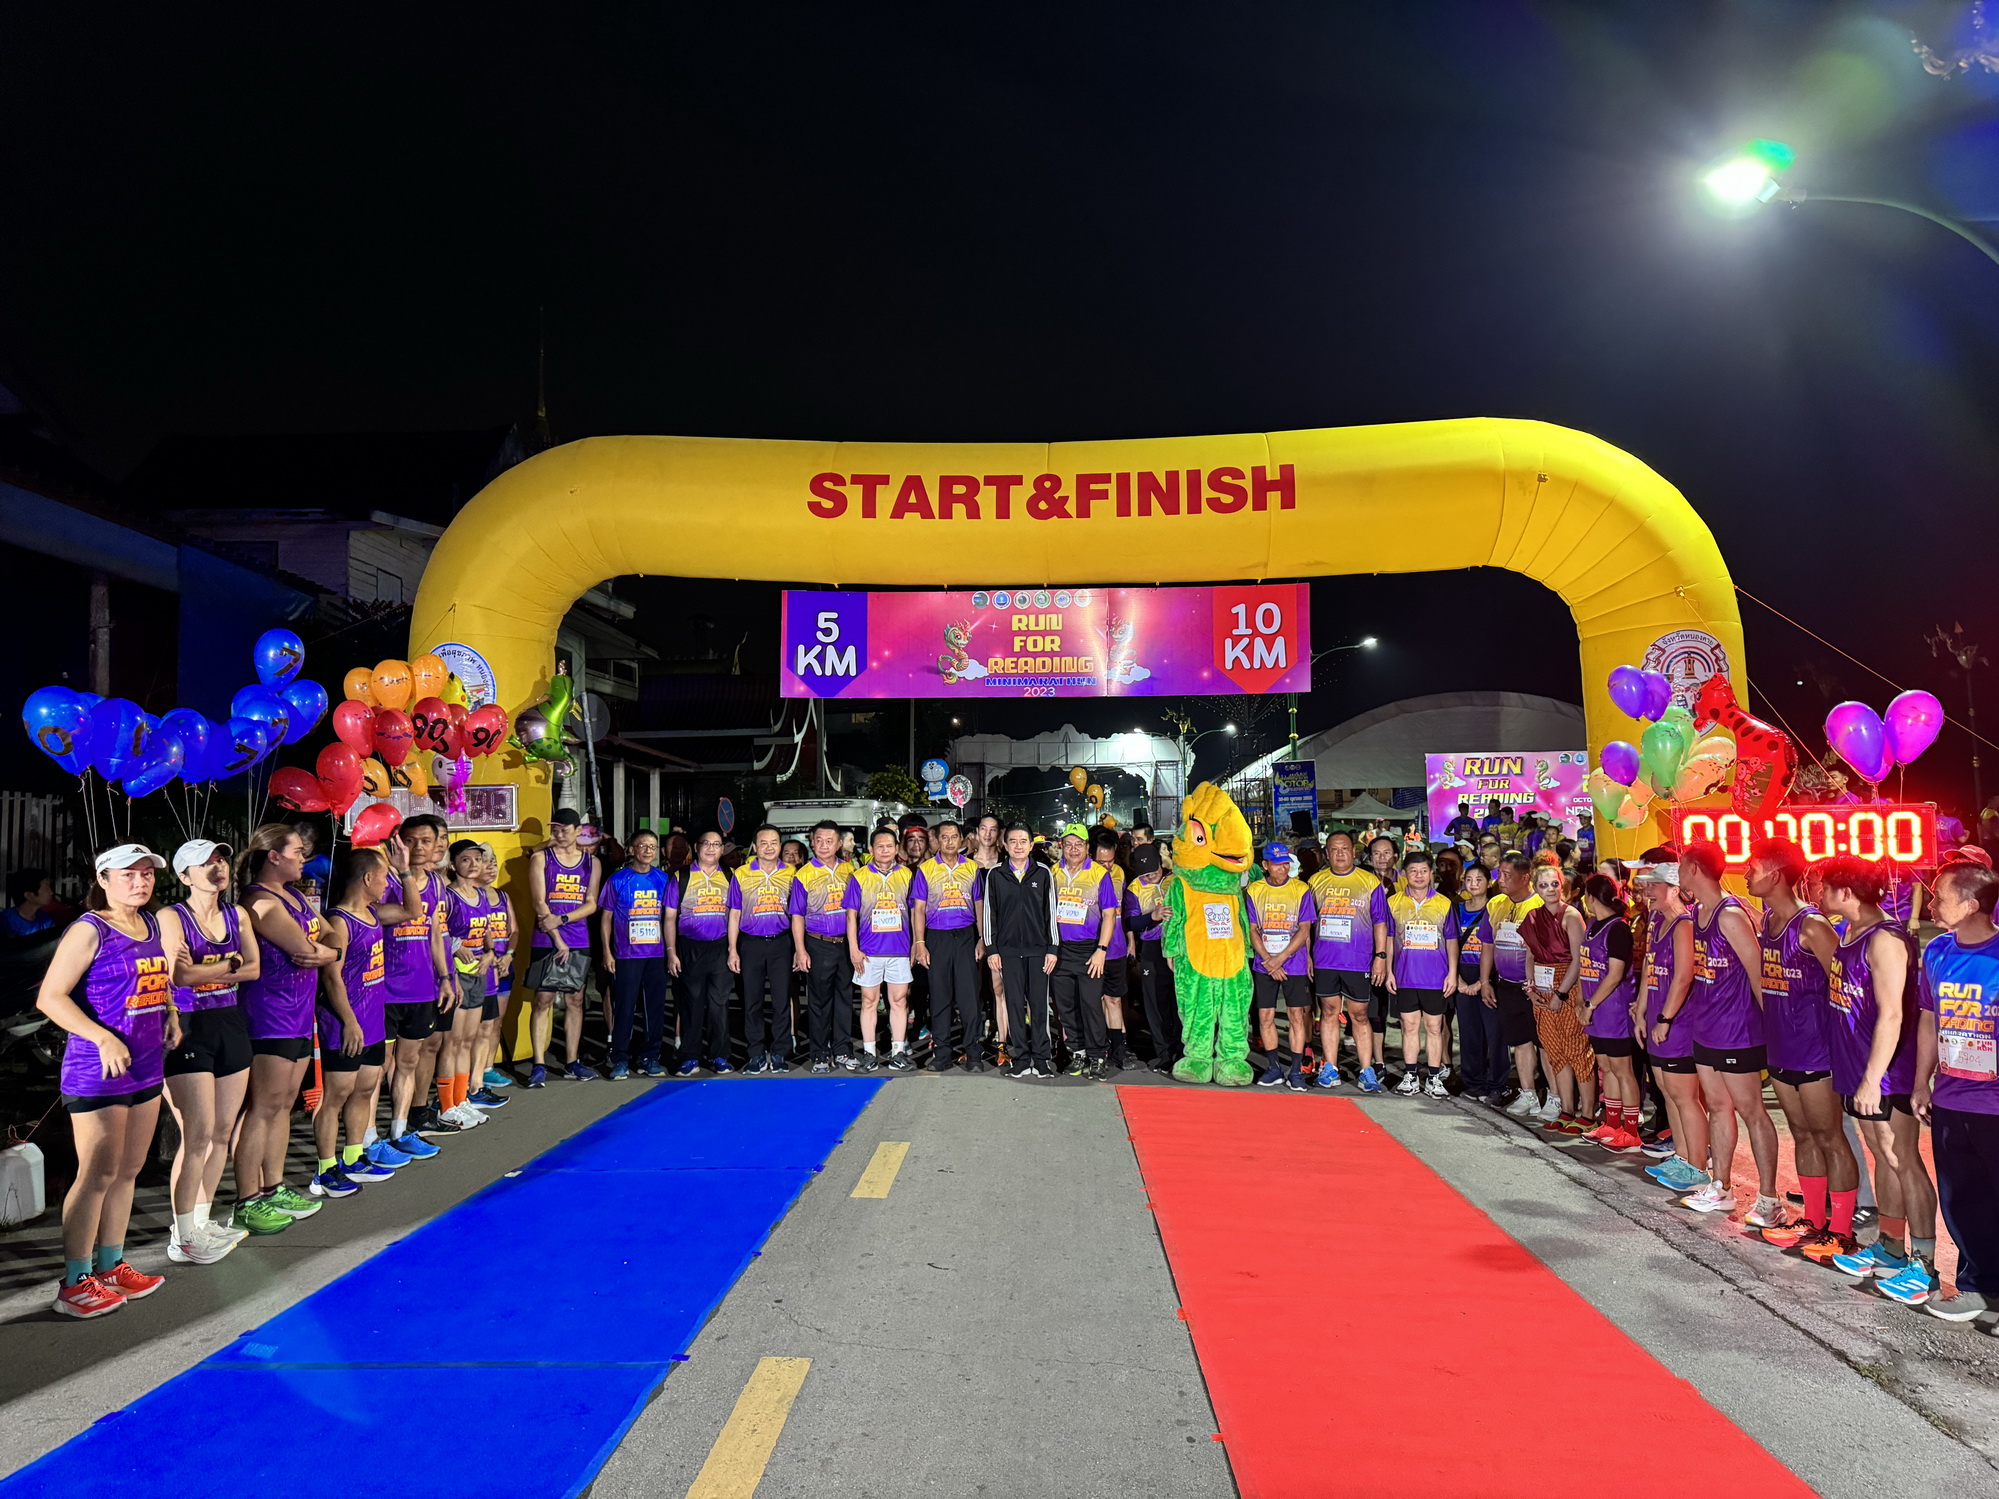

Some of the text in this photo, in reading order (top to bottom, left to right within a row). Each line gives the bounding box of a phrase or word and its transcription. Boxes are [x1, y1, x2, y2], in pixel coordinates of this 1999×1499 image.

[807, 464, 1296, 520] START&FINISH
[1012, 614, 1063, 631] RUN
[1231, 602, 1282, 635] 10
[816, 612, 839, 643] 5
[1013, 636, 1061, 652] FOR
[1224, 636, 1287, 670] KM
[797, 644, 857, 676] KM
[987, 657, 1094, 674] READING
[985, 677, 1097, 687] MINIMARATHON
[1023, 686, 1056, 697] 2023
[1464, 757, 1523, 776] RUN
[556, 874, 580, 883] RUN
[555, 883, 580, 892] FOR
[698, 887, 721, 896] RUN
[758, 886, 779, 895] RUN
[827, 883, 846, 892] RUN
[943, 882, 962, 891] RUN
[634, 890, 657, 898] RUN
[877, 892, 895, 900] RUN
[1060, 888, 1082, 896] RUN
[1326, 888, 1350, 896] RUN
[634, 898, 657, 908] FOR
[698, 896, 722, 905] FOR
[758, 895, 780, 905] FOR
[1325, 897, 1350, 906] FOR
[1265, 903, 1286, 911] RUN
[1265, 912, 1286, 921] FOR
[470, 917, 487, 927] RUN
[1763, 948, 1780, 962] RUN
[136, 956, 168, 974] RUN
[1708, 957, 1728, 967] 2023
[1763, 963, 1783, 978] FOR
[137, 974, 168, 992] FOR
[1938, 982, 1982, 999] RUN
[1940, 999, 1981, 1017] FOR
[1940, 1016, 1994, 1032] EADING
